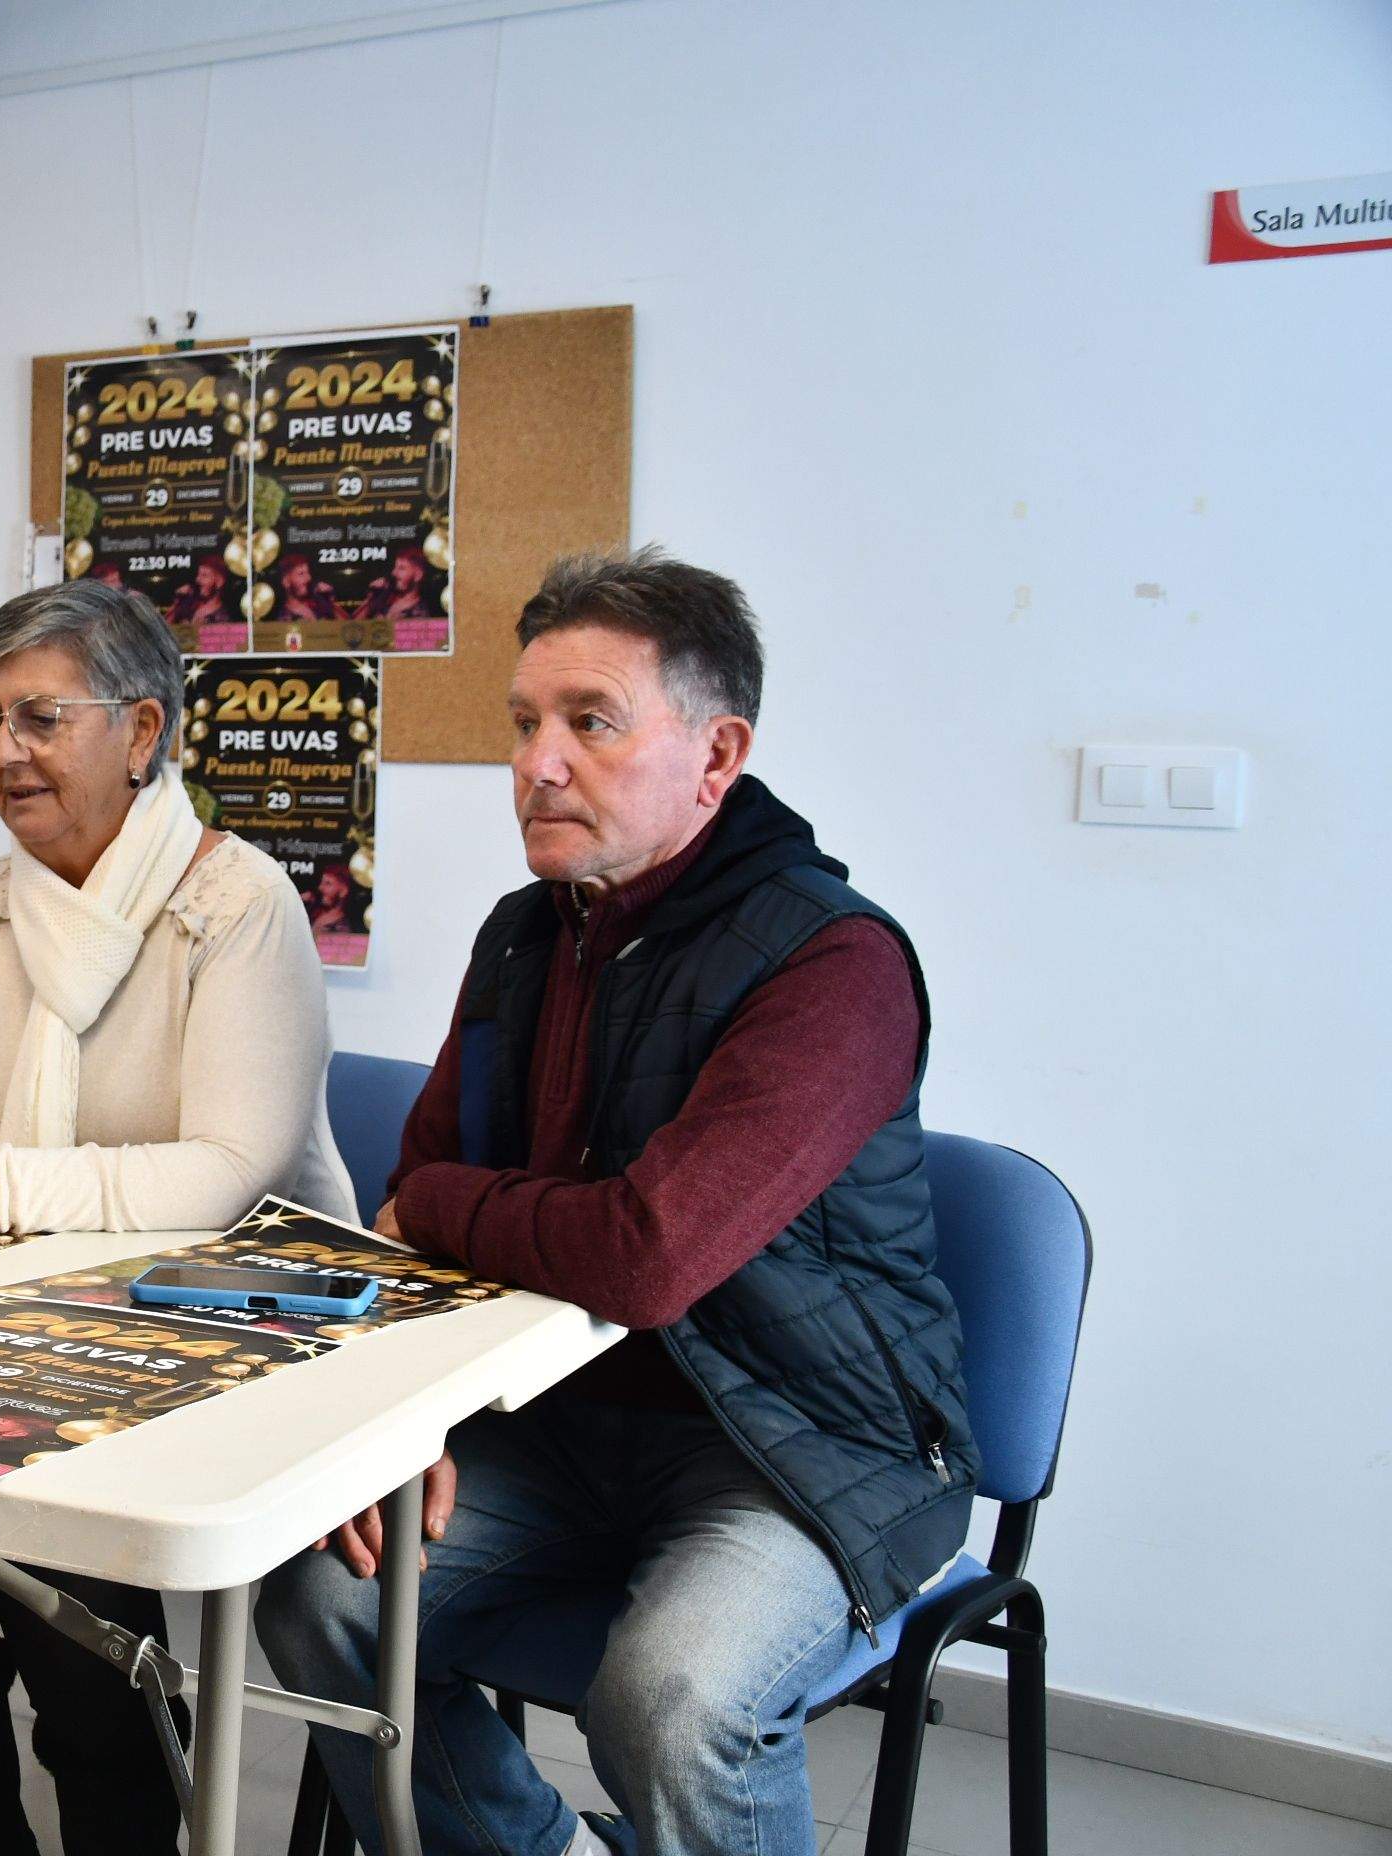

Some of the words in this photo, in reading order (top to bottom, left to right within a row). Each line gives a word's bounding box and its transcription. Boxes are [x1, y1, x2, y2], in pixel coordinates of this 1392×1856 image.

[1251, 206, 1304, 233] Sala
[285, 359, 418, 411] 2024
[97, 376, 219, 425] 2024
[288, 414, 336, 439] PRE
[342, 410, 413, 437] UVAS
[101, 429, 145, 453] PRE
[149, 425, 214, 450] UVAS
[273, 446, 336, 466] Puente
[339, 442, 427, 465] Mayorga
[145, 488, 169, 507] 29
[337, 477, 363, 496] 29
[168, 555, 191, 569] PM
[362, 546, 387, 561] PM
[215, 678, 343, 722] 2024
[219, 730, 267, 750] PRE
[271, 730, 338, 751] UVAS
[205, 756, 265, 776] Puente
[269, 757, 353, 781] Mayorga
[267, 791, 292, 810] 29
[290, 861, 315, 875] PM
[234, 1254, 319, 1272] PRE
[258, 1242, 471, 1283] 2024
[51, 1341, 187, 1370] UVAS
[11, 1351, 180, 1386] Mayorga
[40, 1375, 132, 1396] DICIEMBRE
